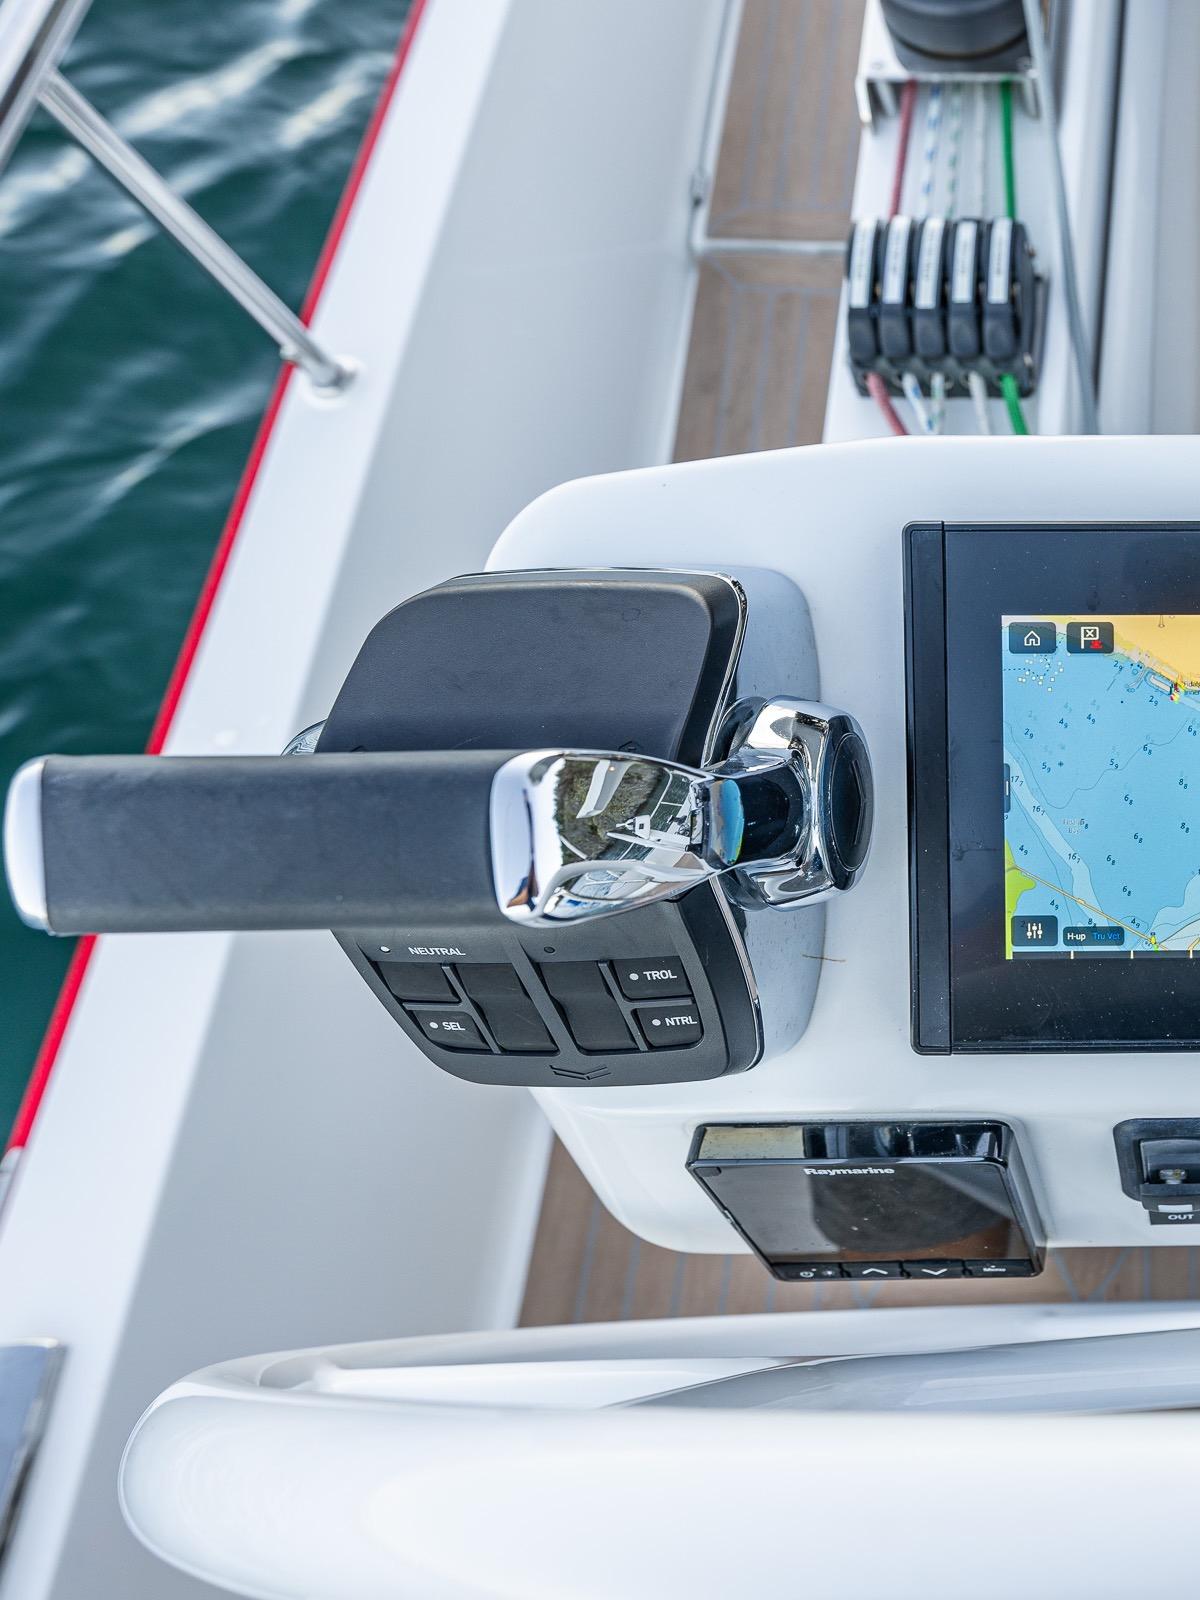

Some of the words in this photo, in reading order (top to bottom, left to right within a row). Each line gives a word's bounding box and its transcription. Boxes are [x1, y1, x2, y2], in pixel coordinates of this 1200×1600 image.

[1067, 933, 1086, 942] H-up
[408, 946, 466, 958] NEUTRAL
[643, 970, 678, 982] TROL
[665, 1015, 698, 1026] NTRL
[442, 1021, 466, 1032] SEL
[803, 1166, 895, 1176] Raymarine
